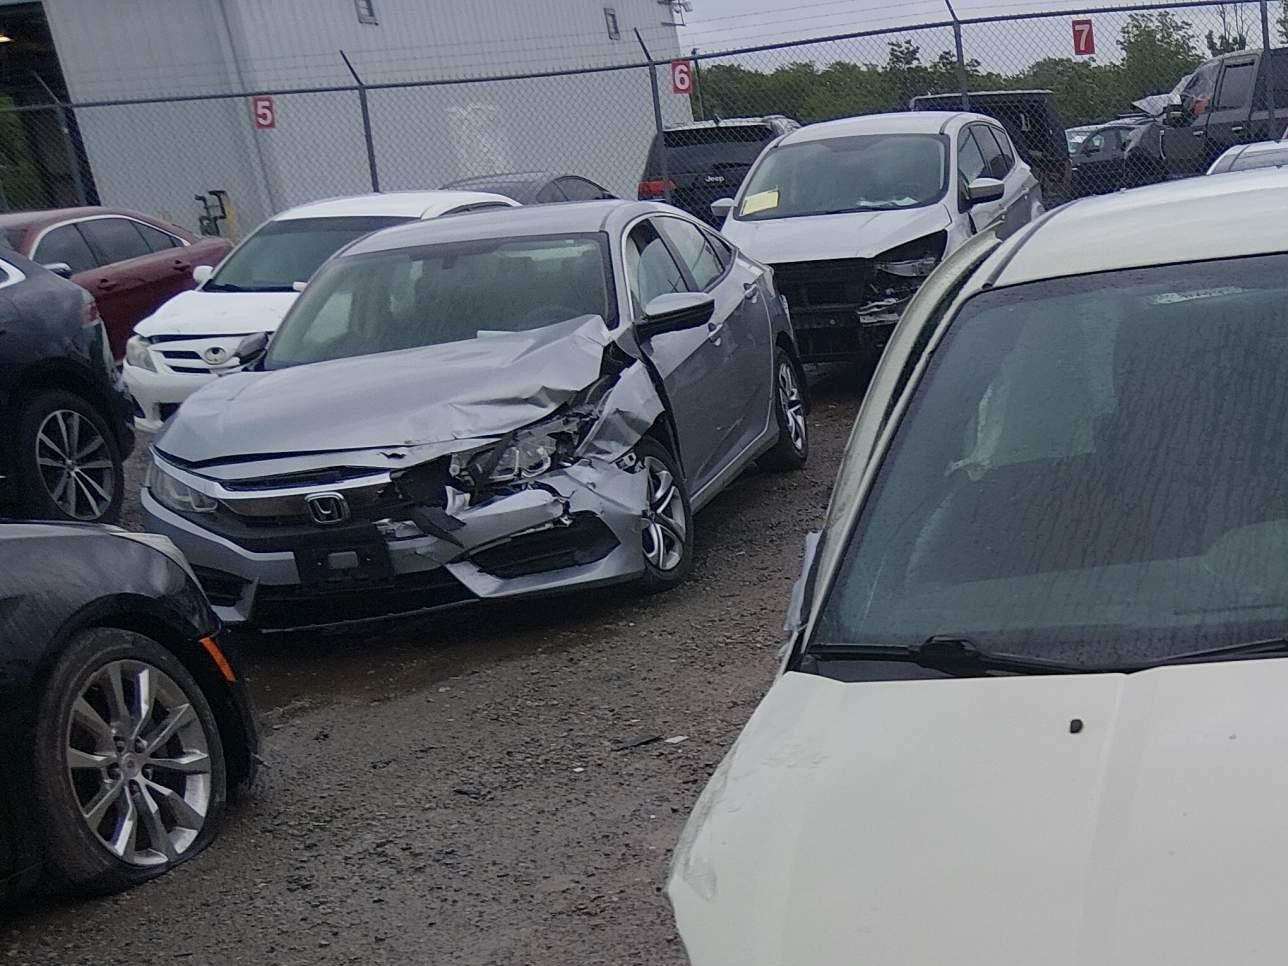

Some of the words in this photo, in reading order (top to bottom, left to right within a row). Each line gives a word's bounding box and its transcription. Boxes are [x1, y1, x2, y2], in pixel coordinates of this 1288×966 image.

[1074, 24, 1090, 51] 7
[674, 64, 690, 90] 6
[256, 101, 272, 126] 5
